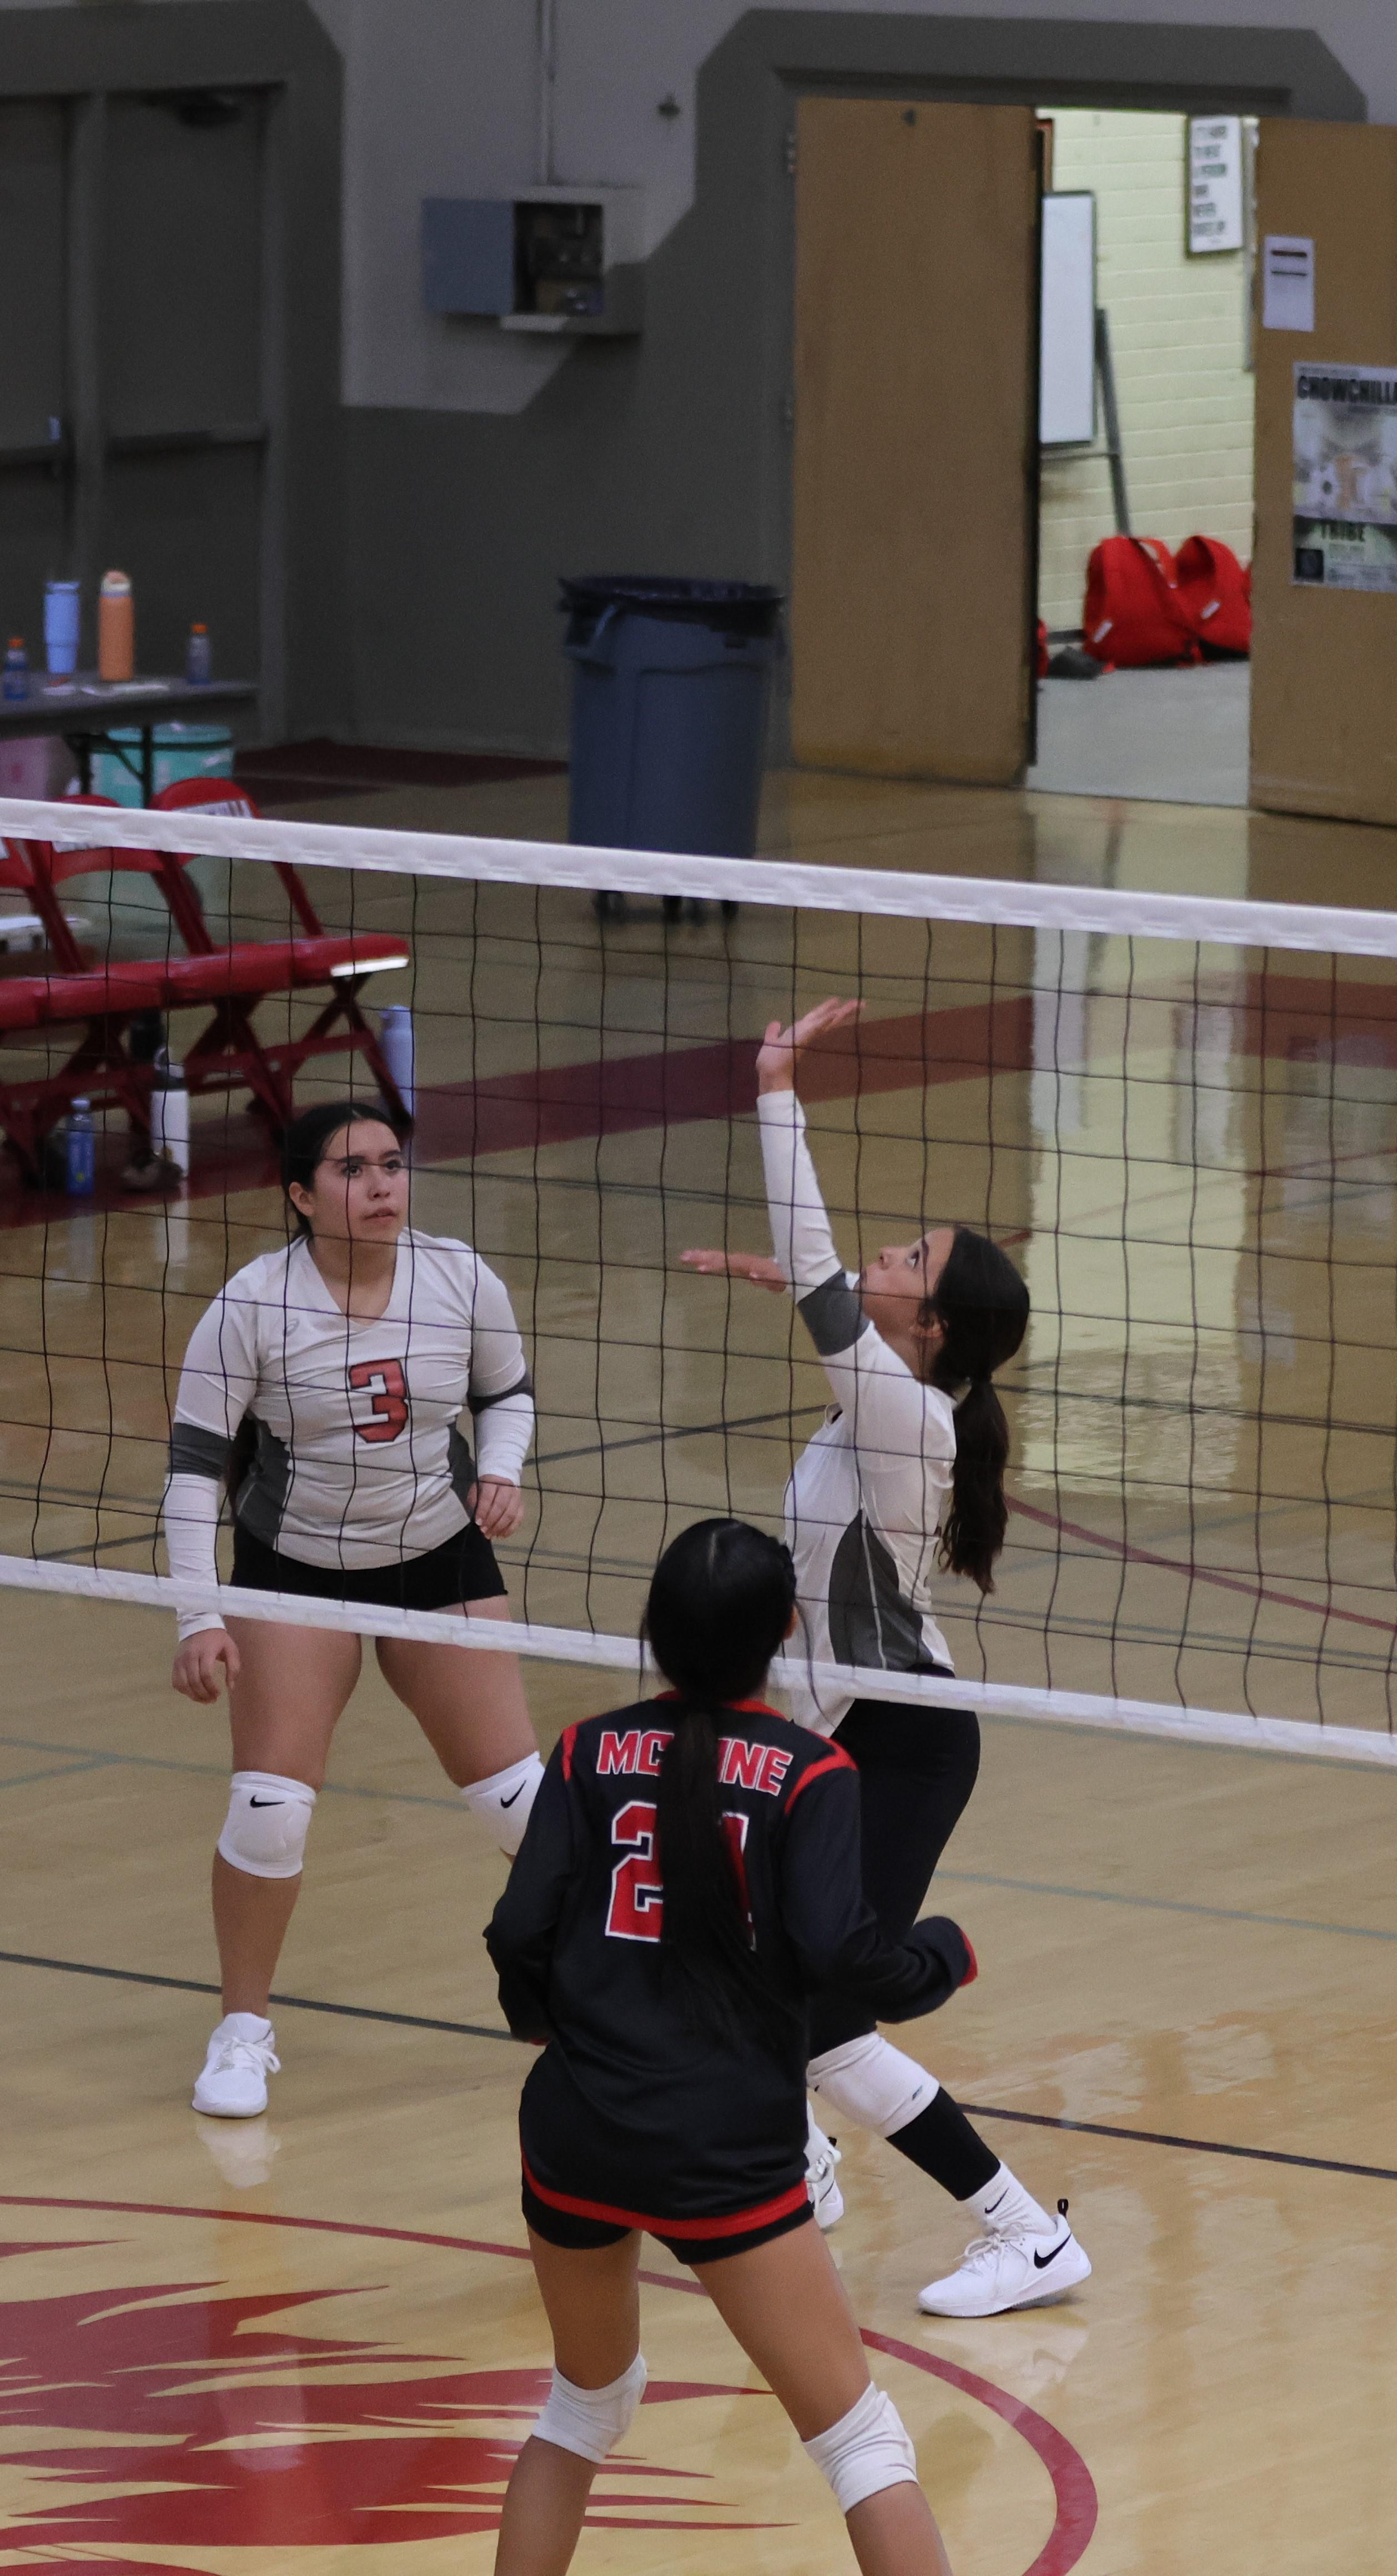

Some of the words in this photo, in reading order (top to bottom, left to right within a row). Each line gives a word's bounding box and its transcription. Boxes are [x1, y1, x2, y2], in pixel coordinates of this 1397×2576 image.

[1297, 375, 1397, 405] CHOWCHILL
[1318, 519, 1365, 542] TRIBE
[348, 1359, 409, 1443] 3
[596, 1729, 794, 1797] MCINE
